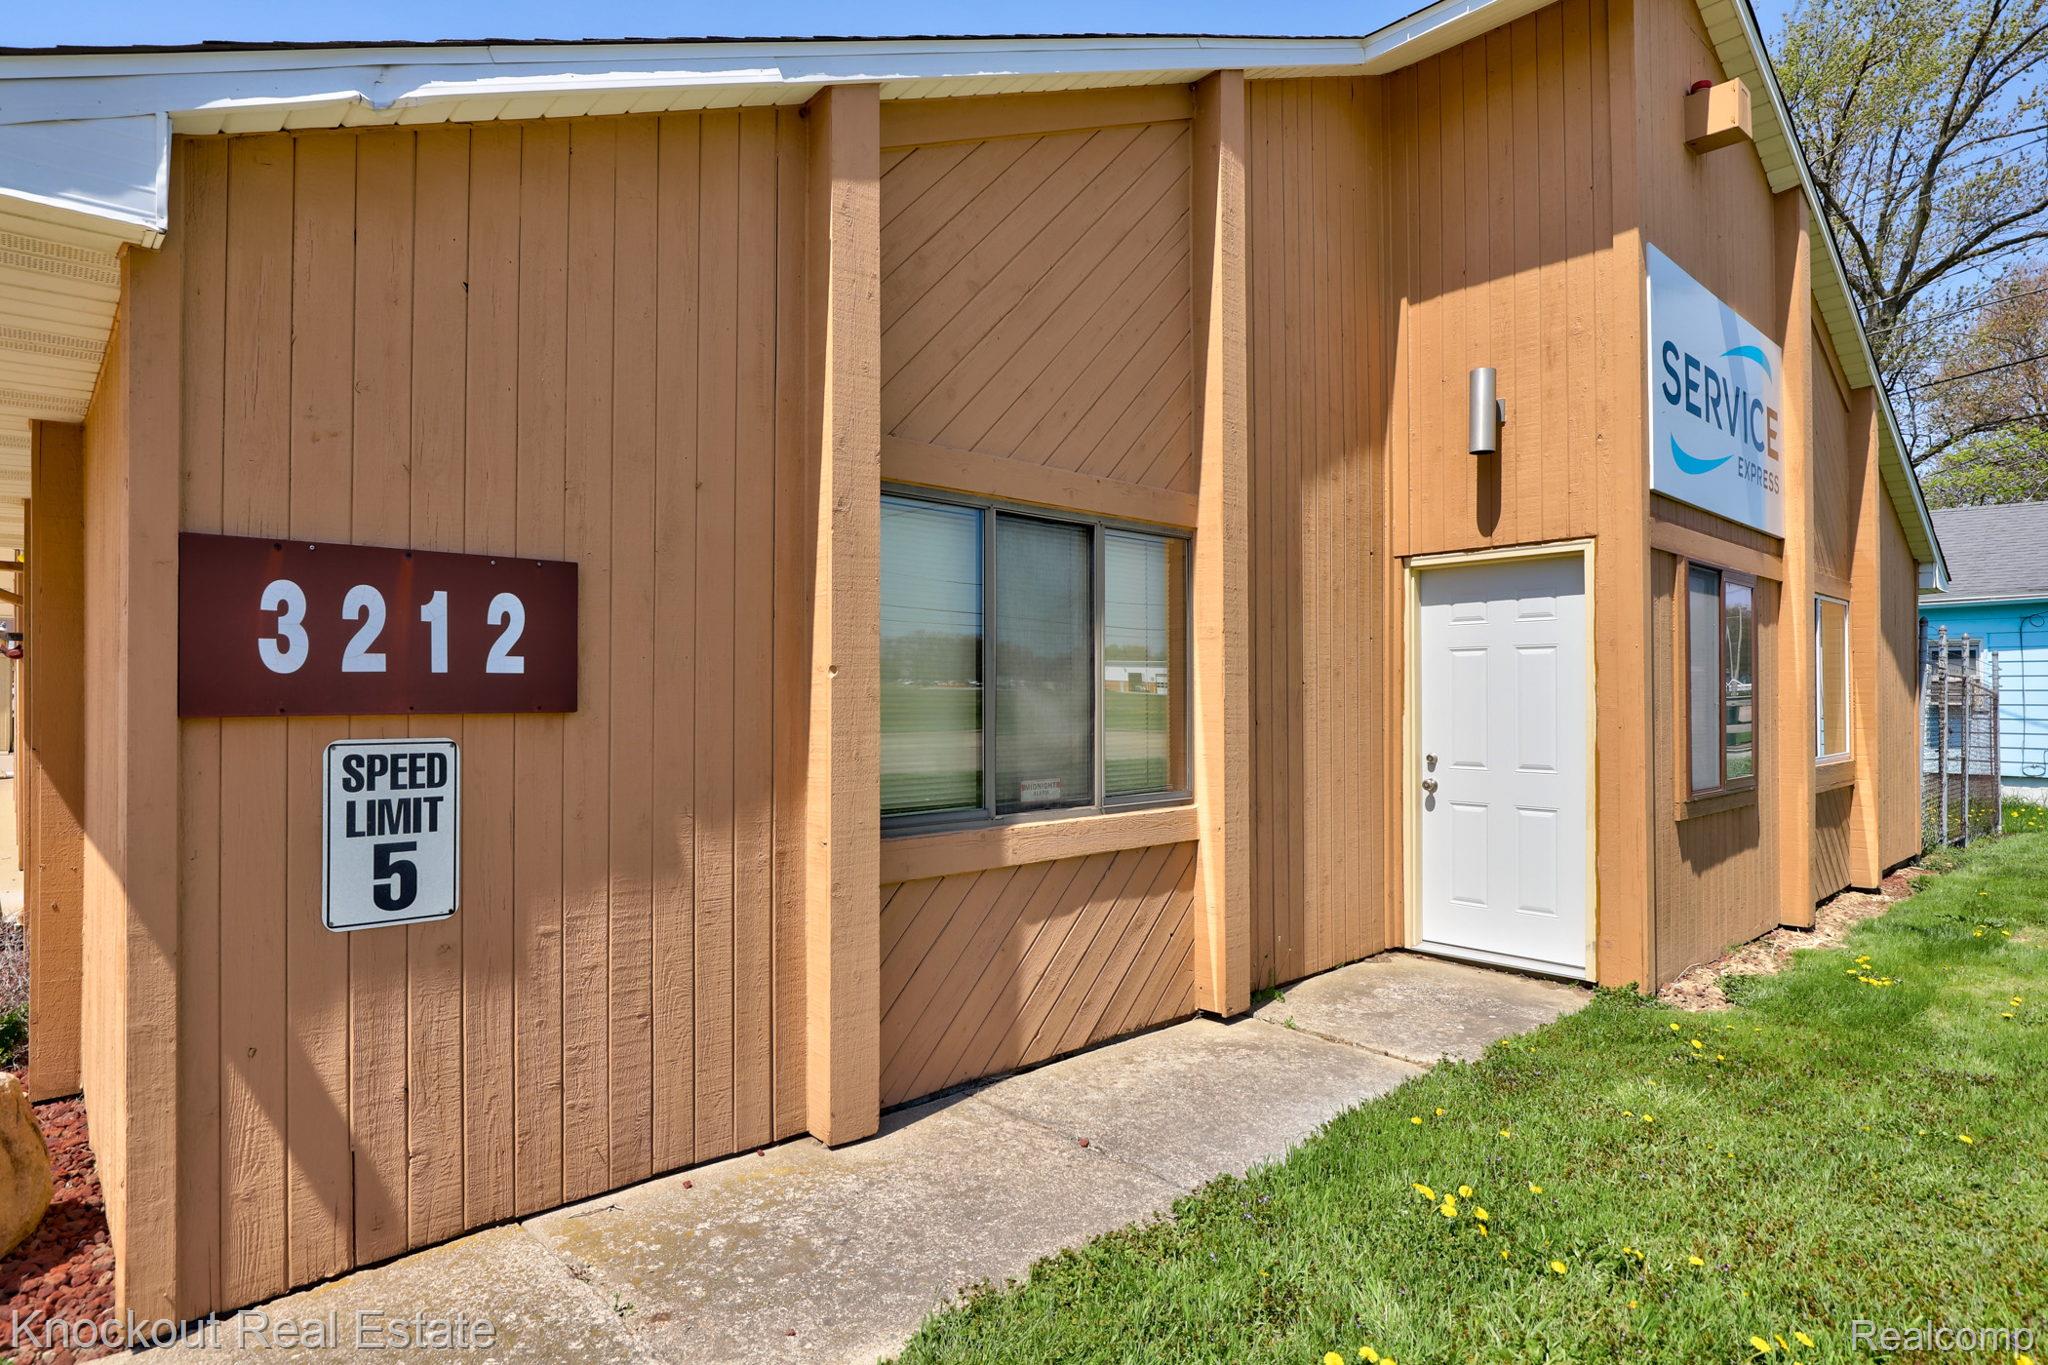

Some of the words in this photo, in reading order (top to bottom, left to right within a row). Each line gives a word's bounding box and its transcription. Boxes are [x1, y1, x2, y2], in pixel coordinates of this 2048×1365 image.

[1662, 340, 1779, 461] SERVICE
[1738, 457, 1780, 494] EXPRESS
[342, 752, 448, 793] SPEED
[346, 796, 444, 838] LIMIT
[373, 841, 418, 911] 5
